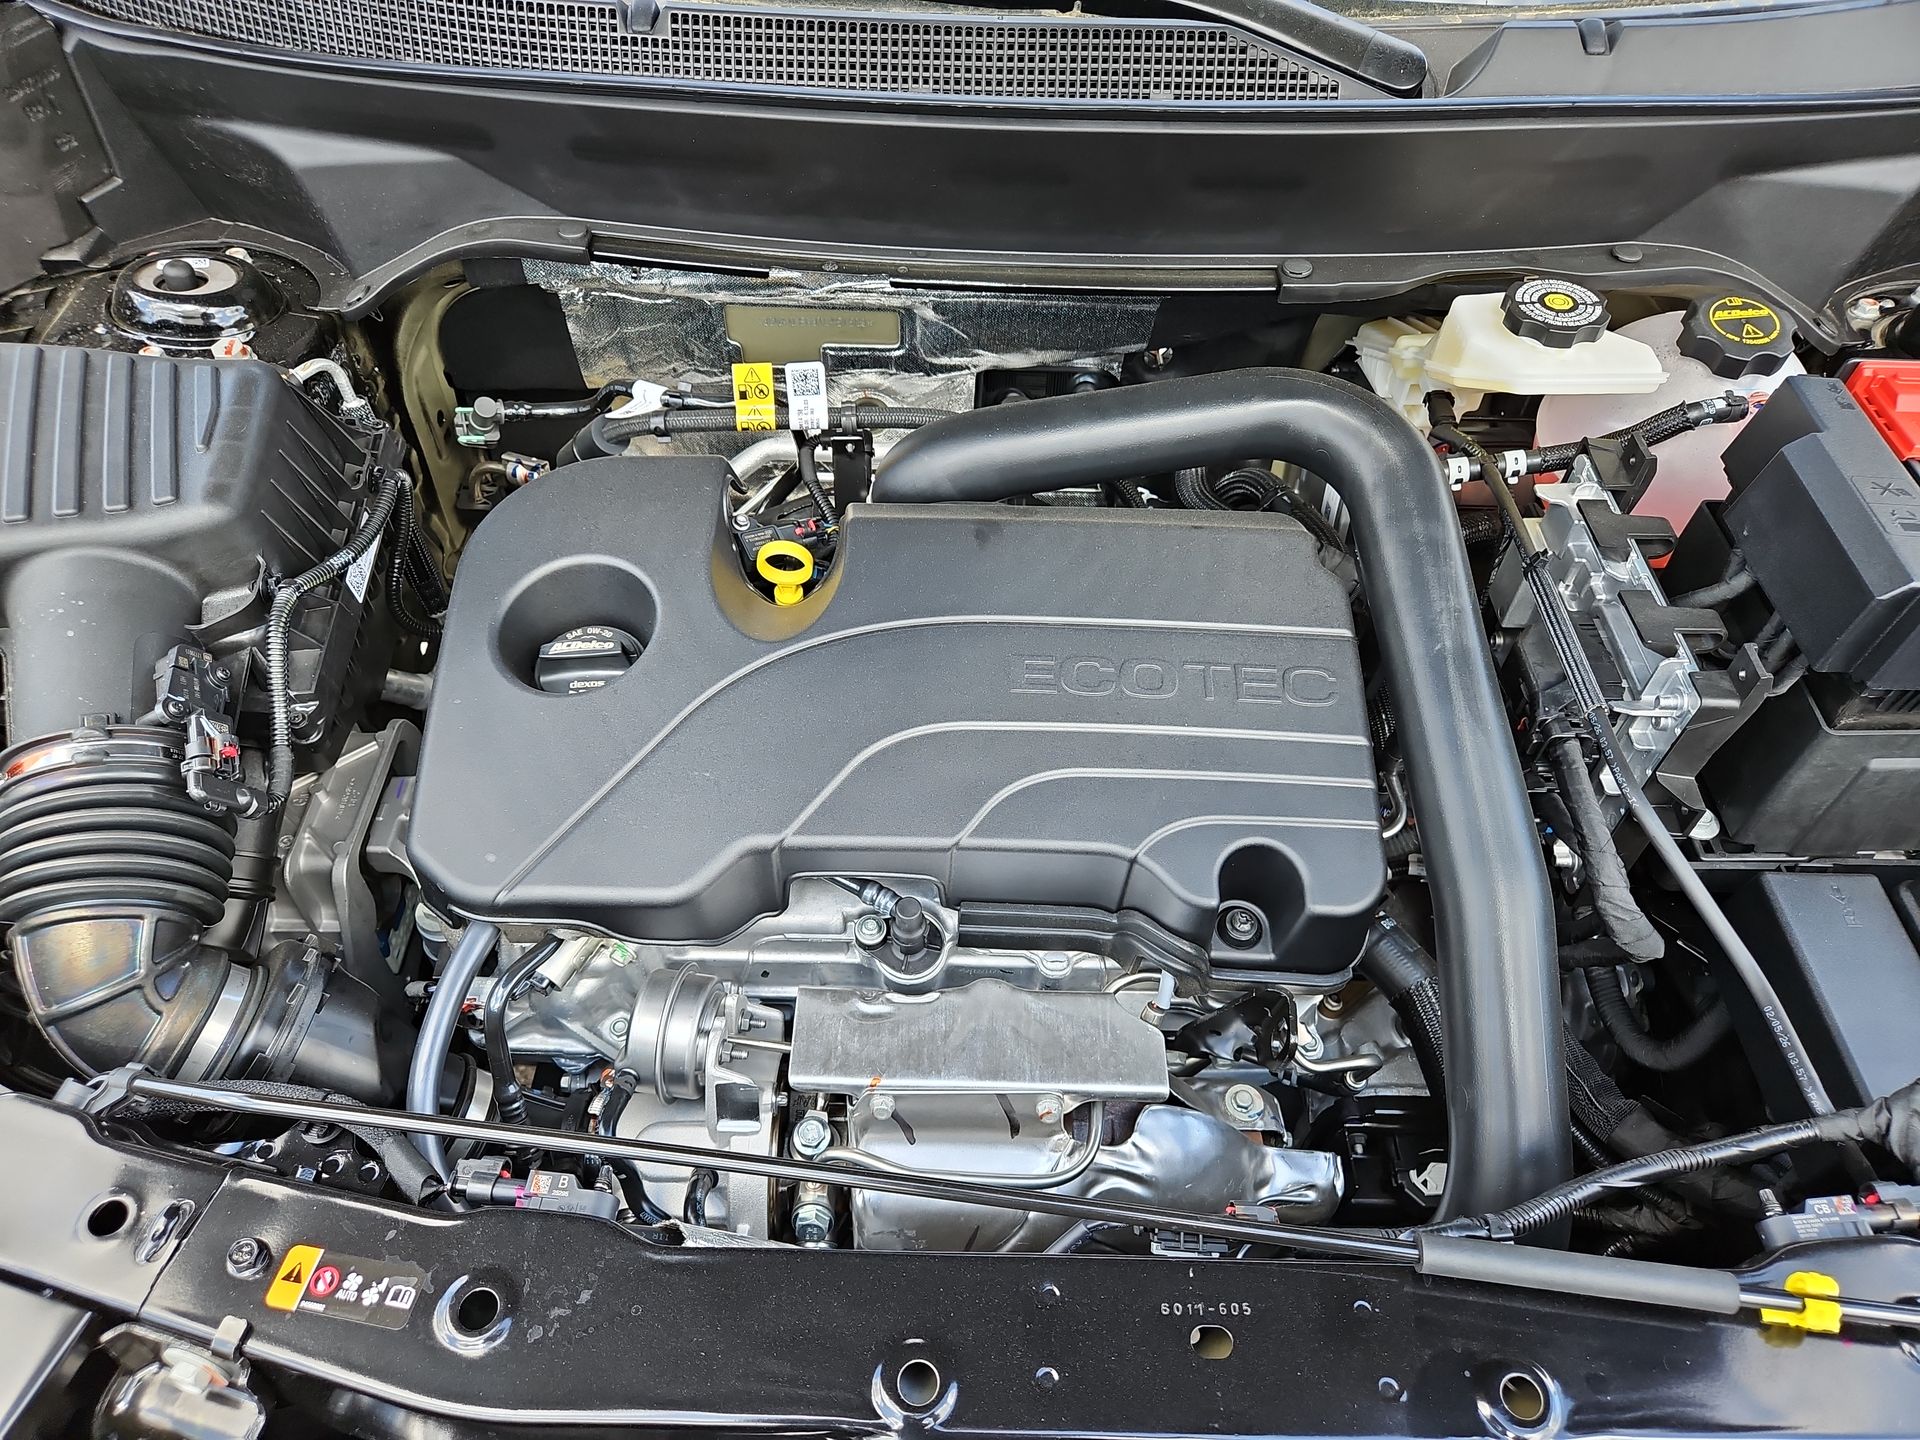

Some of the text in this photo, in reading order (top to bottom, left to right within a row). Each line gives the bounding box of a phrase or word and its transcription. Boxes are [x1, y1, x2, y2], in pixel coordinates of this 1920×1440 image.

[1714, 308, 1769, 319] ACDelco
[566, 628, 583, 640] SAE
[549, 640, 615, 652] ACDelco
[569, 680, 606, 689] dexos
[1009, 655, 1339, 707] ECOTEC
[1763, 1005, 1791, 1048] 02/05/26
[1787, 1051, 1808, 1081] 03:57
[558, 1175, 569, 1188] B
[1814, 1204, 1831, 1214] CB
[335, 1288, 358, 1302] AUTO
[1160, 1303, 1252, 1316] 6011-605
